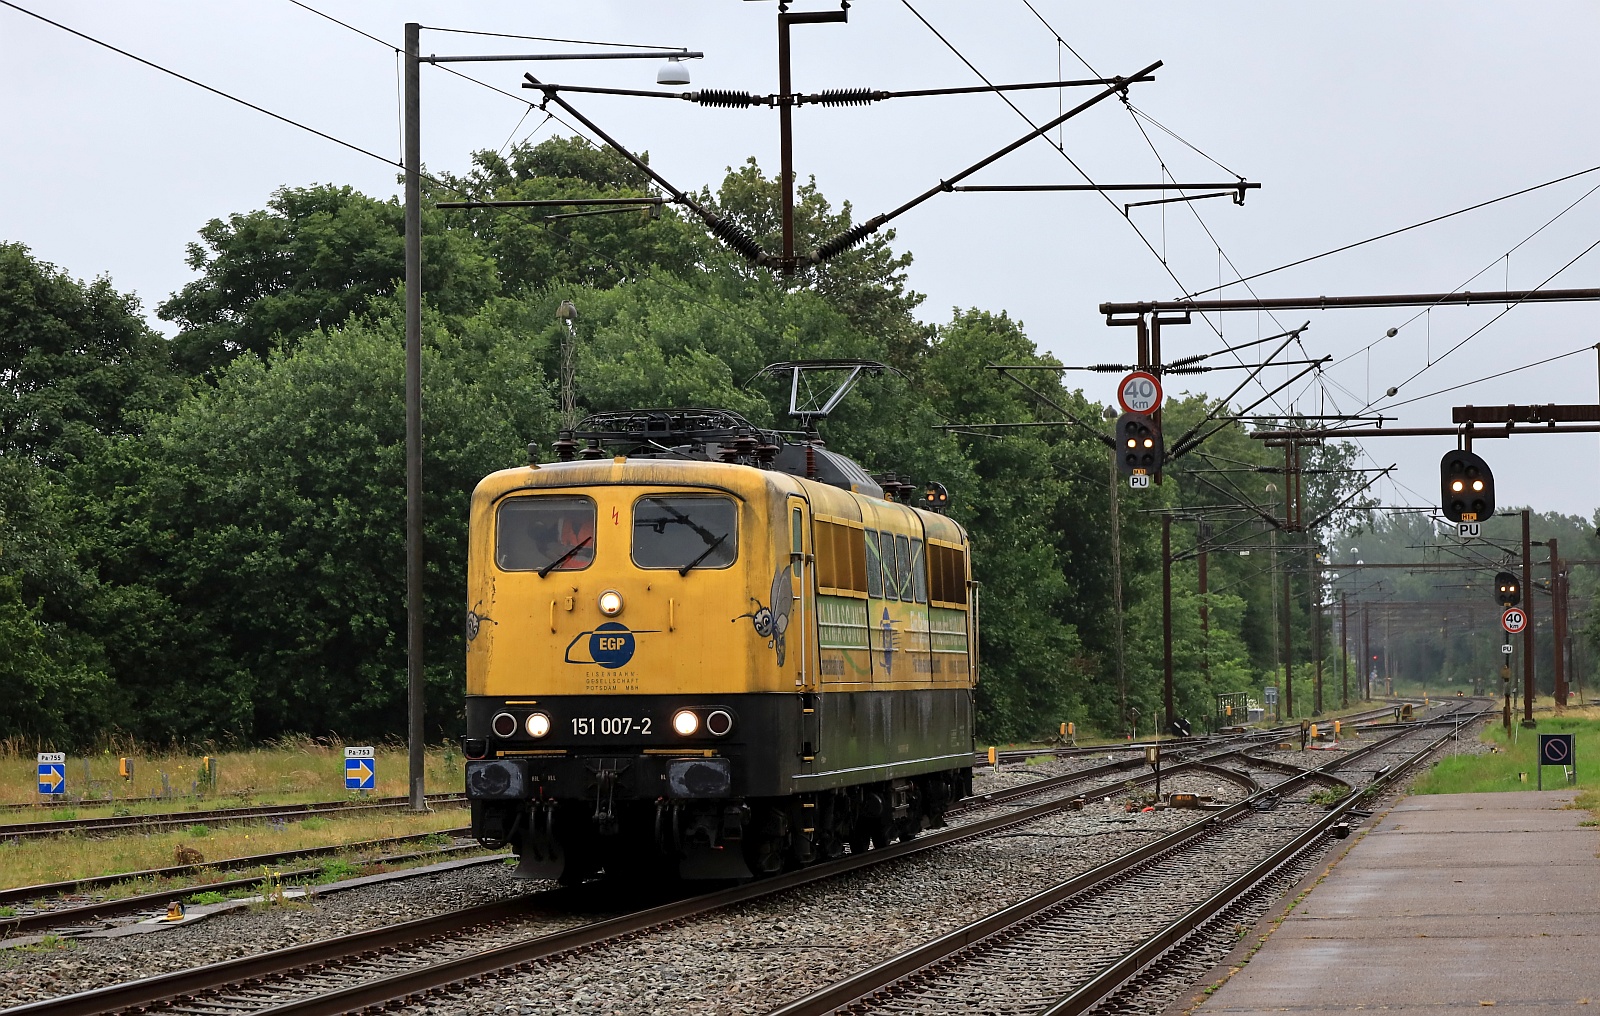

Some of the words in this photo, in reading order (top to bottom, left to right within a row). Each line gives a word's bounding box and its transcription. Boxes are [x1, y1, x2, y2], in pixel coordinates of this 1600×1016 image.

[1124, 380, 1154, 399] 40
[1132, 400, 1149, 409] km
[1131, 477, 1147, 487] PU
[1460, 524, 1479, 536] PU
[1506, 613, 1522, 623] 40
[599, 637, 626, 651] EGP
[571, 718, 596, 735] 151
[600, 717, 652, 735] 007-2
